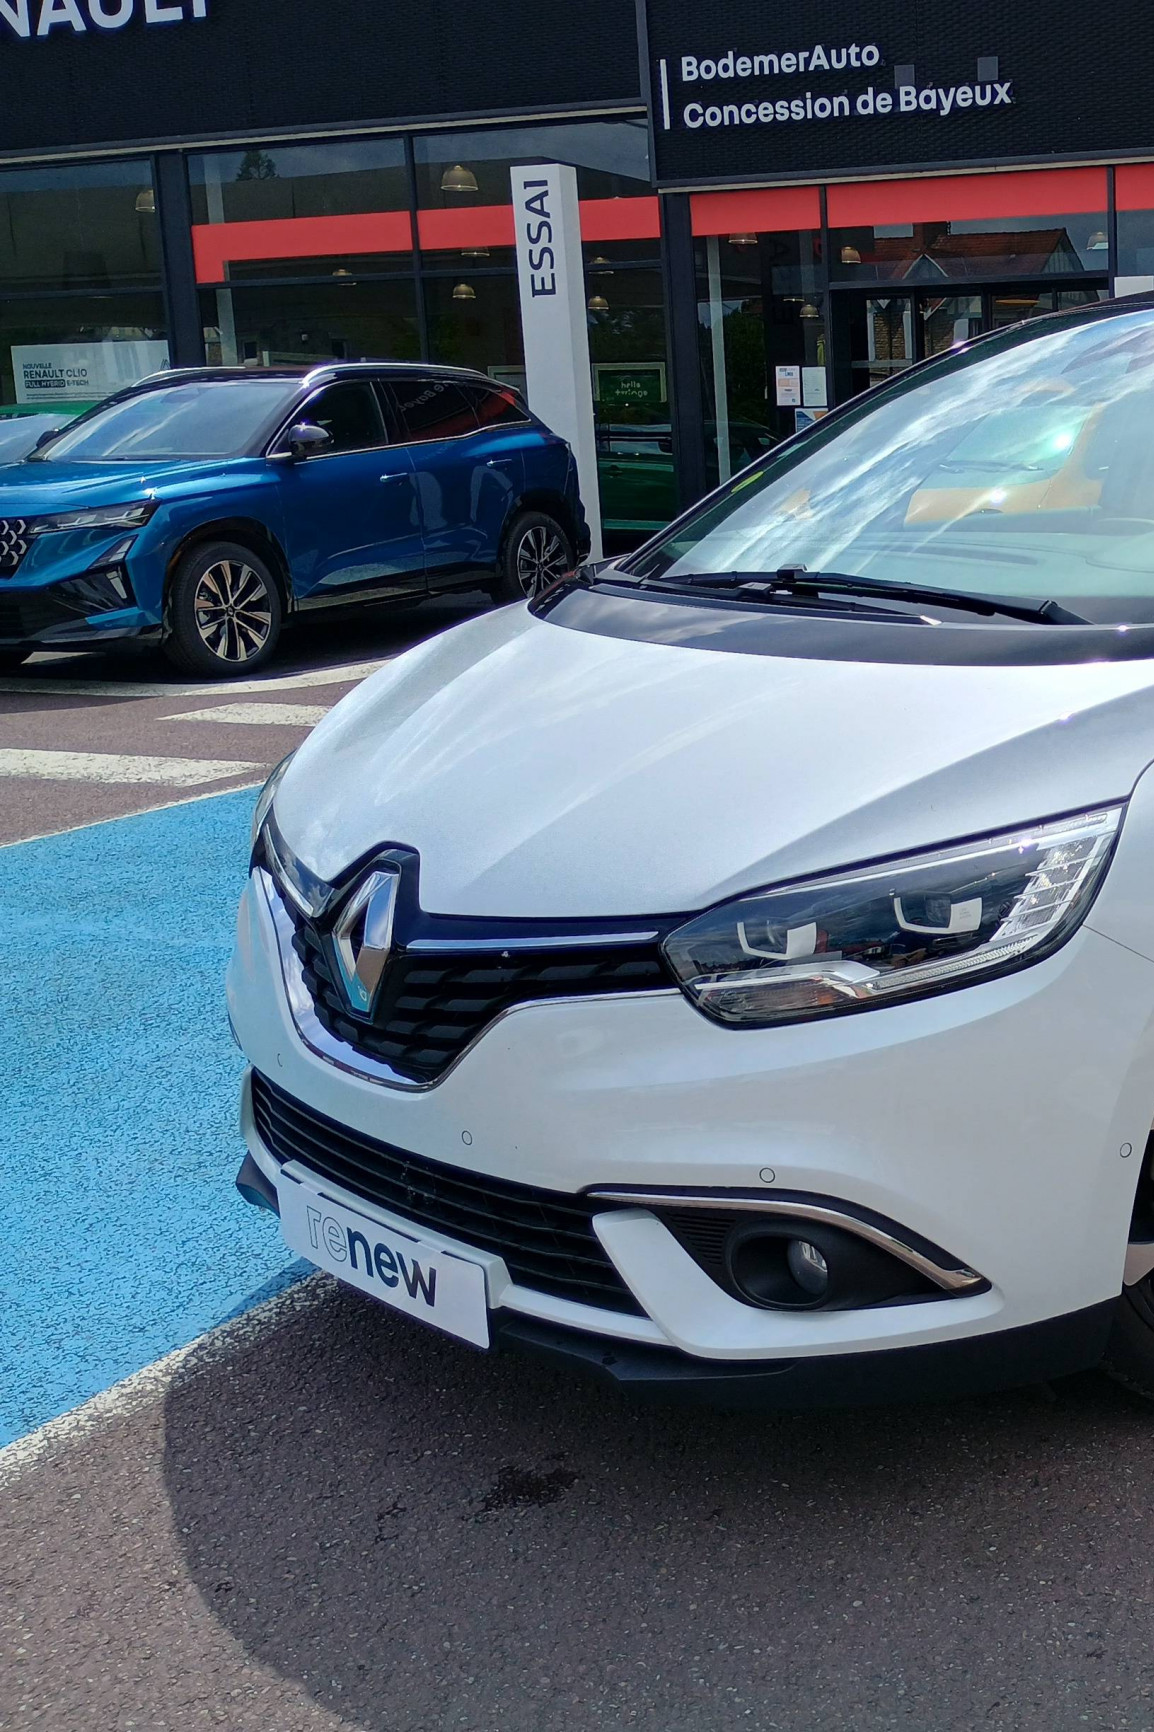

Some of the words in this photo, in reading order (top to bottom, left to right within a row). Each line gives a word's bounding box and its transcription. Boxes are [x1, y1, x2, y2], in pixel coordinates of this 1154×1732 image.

[681, 43, 880, 81] BodemerAuto
[683, 92, 850, 128] Concession
[856, 87, 893, 115] de
[899, 82, 1012, 116] Bayeux
[523, 180, 556, 297] ESSAI
[23, 369, 65, 379] RENAULT
[65, 368, 88, 378] CLIO
[25, 380, 41, 388] FULL
[67, 379, 89, 387] E-TECH
[306, 1205, 437, 1307] renew
